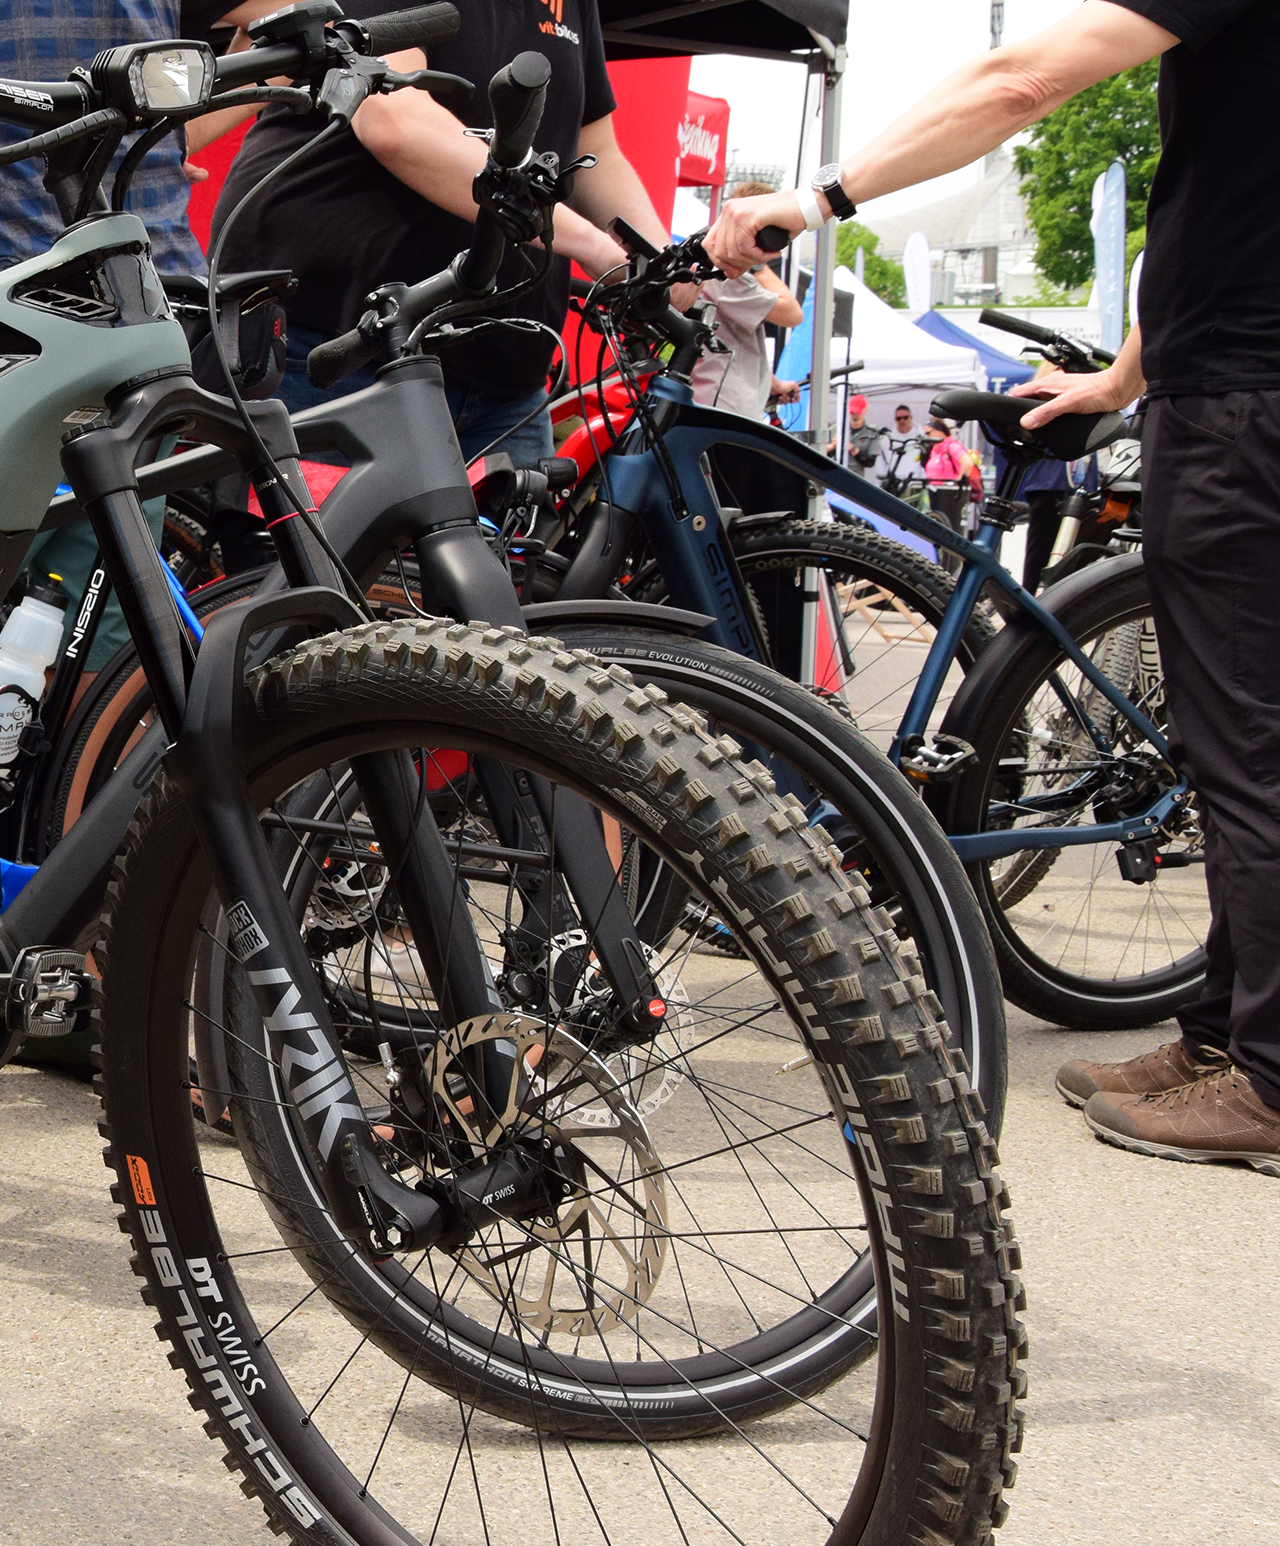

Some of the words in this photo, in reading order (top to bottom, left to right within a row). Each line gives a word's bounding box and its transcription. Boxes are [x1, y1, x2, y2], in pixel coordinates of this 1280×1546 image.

[13, 97, 54, 112] SIMPLON
[701, 542, 754, 656] SIMP
[649, 650, 709, 671] EVOLUTION
[677, 849, 830, 1041] MARY
[248, 967, 366, 1163] LYRIK
[130, 1156, 147, 1204] ADDIX
[146, 1187, 154, 1202] SOFT
[357, 1190, 373, 1225] MAXLE
[495, 1184, 516, 1201] SWISS
[830, 1062, 910, 1323] MAGIC
[185, 1257, 224, 1304] DT
[208, 1311, 267, 1396] SWISS
[139, 1209, 322, 1530] SCHWALBE
[422, 1328, 519, 1381] MARATHON
[518, 1378, 575, 1401] SUPREME
